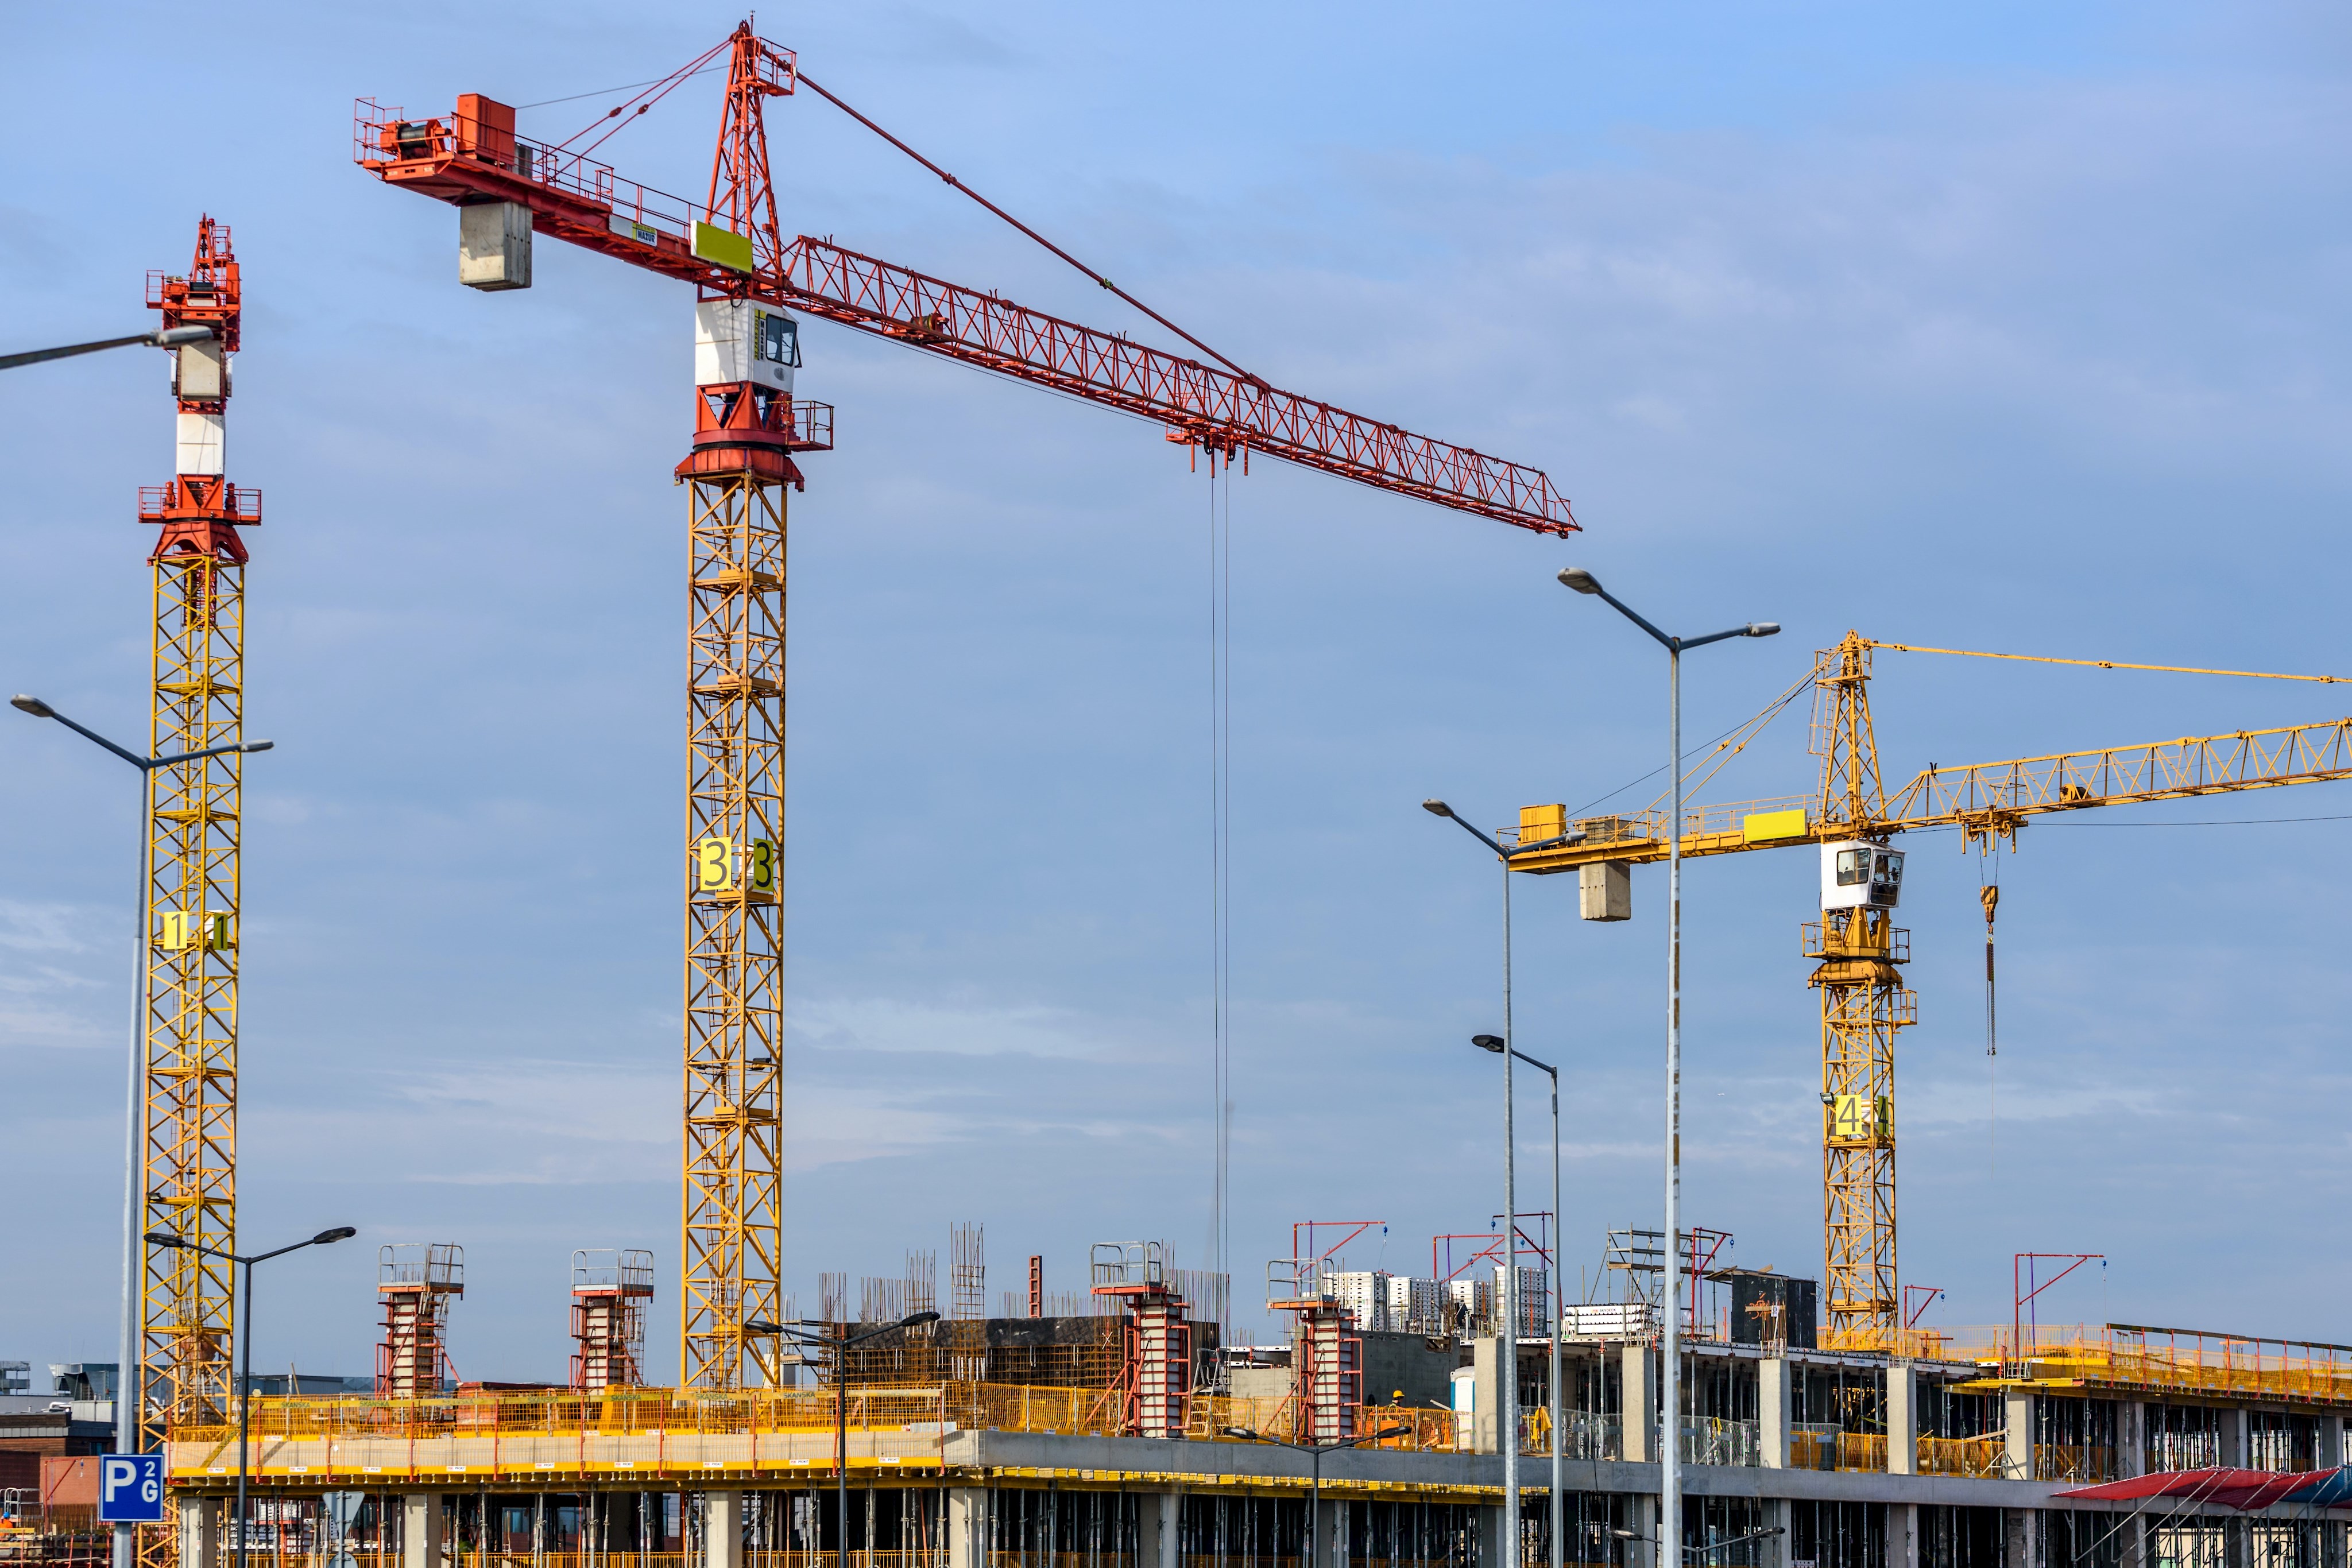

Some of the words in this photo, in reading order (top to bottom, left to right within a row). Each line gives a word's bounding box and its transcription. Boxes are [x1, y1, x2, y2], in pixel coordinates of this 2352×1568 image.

[638, 230, 655, 243] MAZUR
[705, 841, 727, 886] 3
[756, 842, 771, 888] 3
[172, 913, 181, 947] 1
[218, 915, 225, 948] 1
[1838, 1097, 1859, 1132] 4
[1878, 1098, 1888, 1133] 4
[105, 1459, 137, 1502] P
[145, 1461, 156, 1477] 2
[141, 1479, 158, 1503] G
